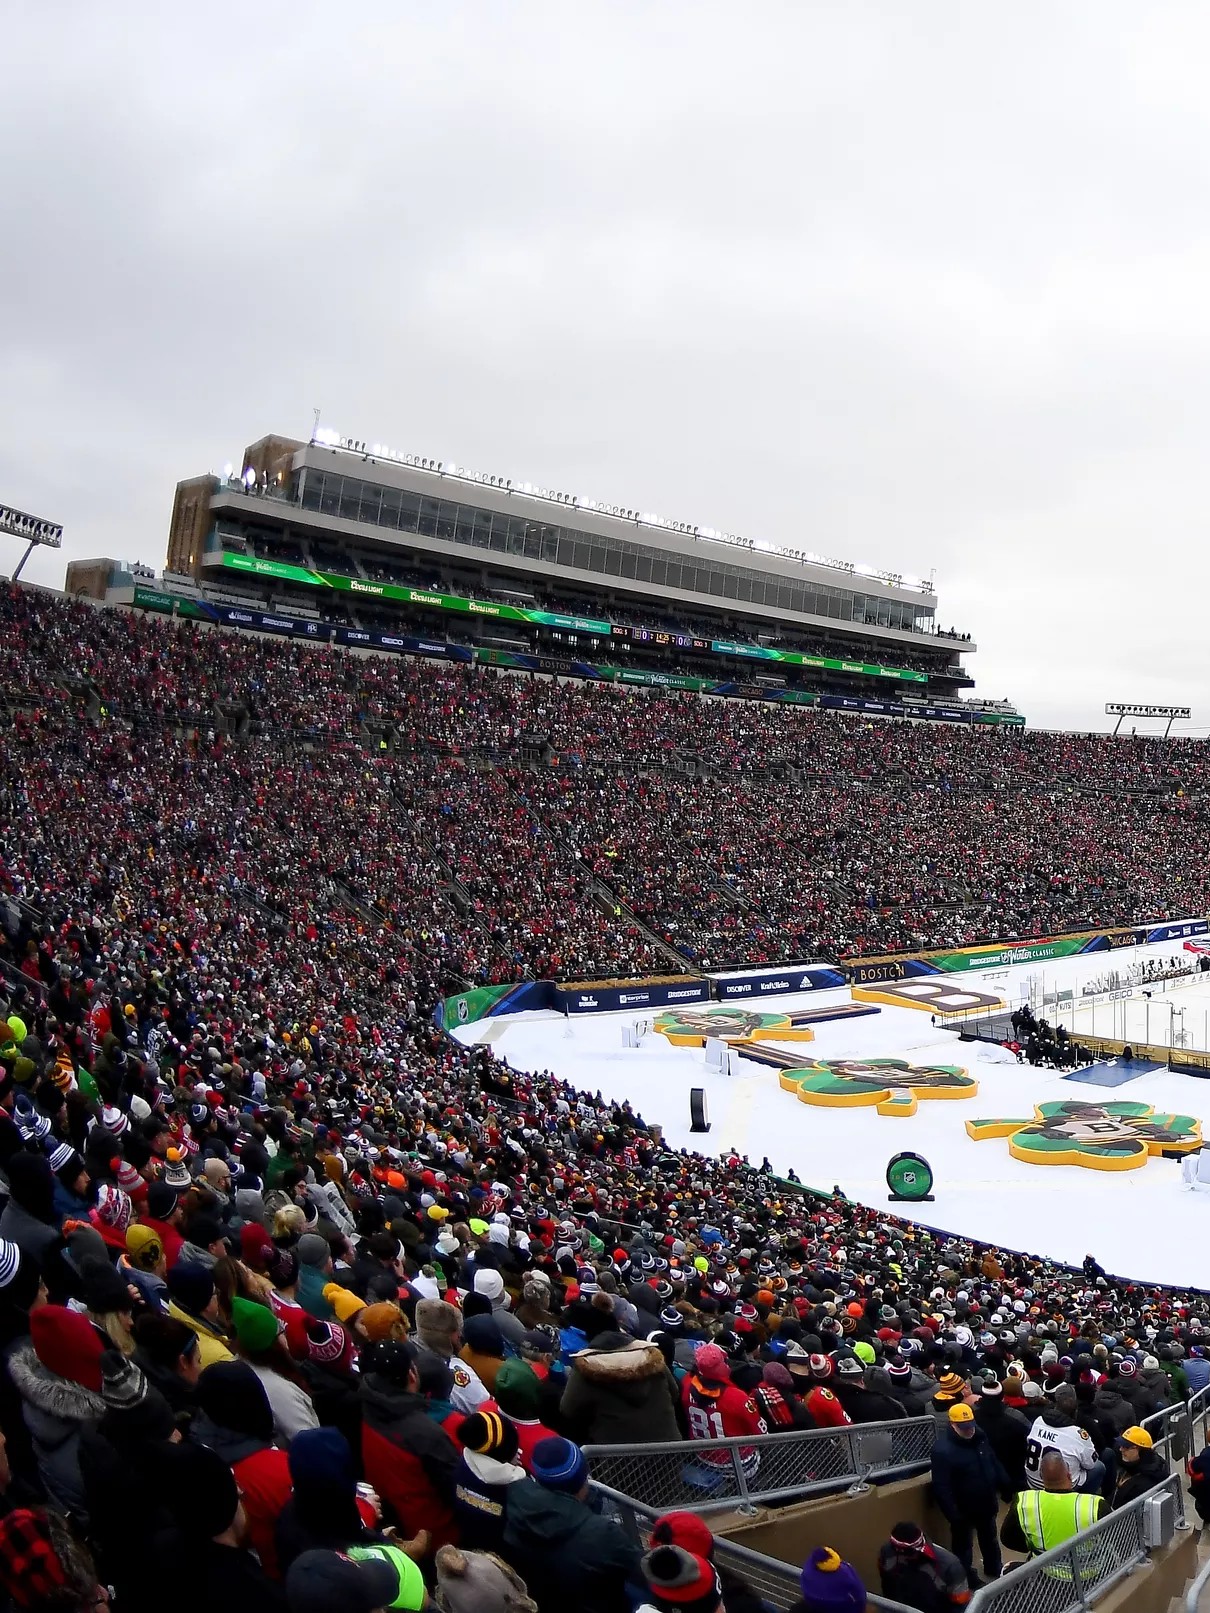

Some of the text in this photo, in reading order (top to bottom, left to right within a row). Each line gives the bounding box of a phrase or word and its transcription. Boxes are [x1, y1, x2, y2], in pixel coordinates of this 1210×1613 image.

[347, 632, 370, 641] DISCOVER
[381, 637, 403, 646] GEICO
[539, 659, 571, 672] BOSTON
[738, 687, 764, 696] CHICAGO
[1007, 948, 1032, 965] Winter
[1032, 948, 1056, 958] CLASSIC
[667, 988, 702, 999] BRIDGESTONE
[726, 984, 752, 993] DISCOVER
[1108, 989, 1133, 1002] GEICO
[688, 1405, 726, 1441] 81
[1037, 1428, 1059, 1443] KANE
